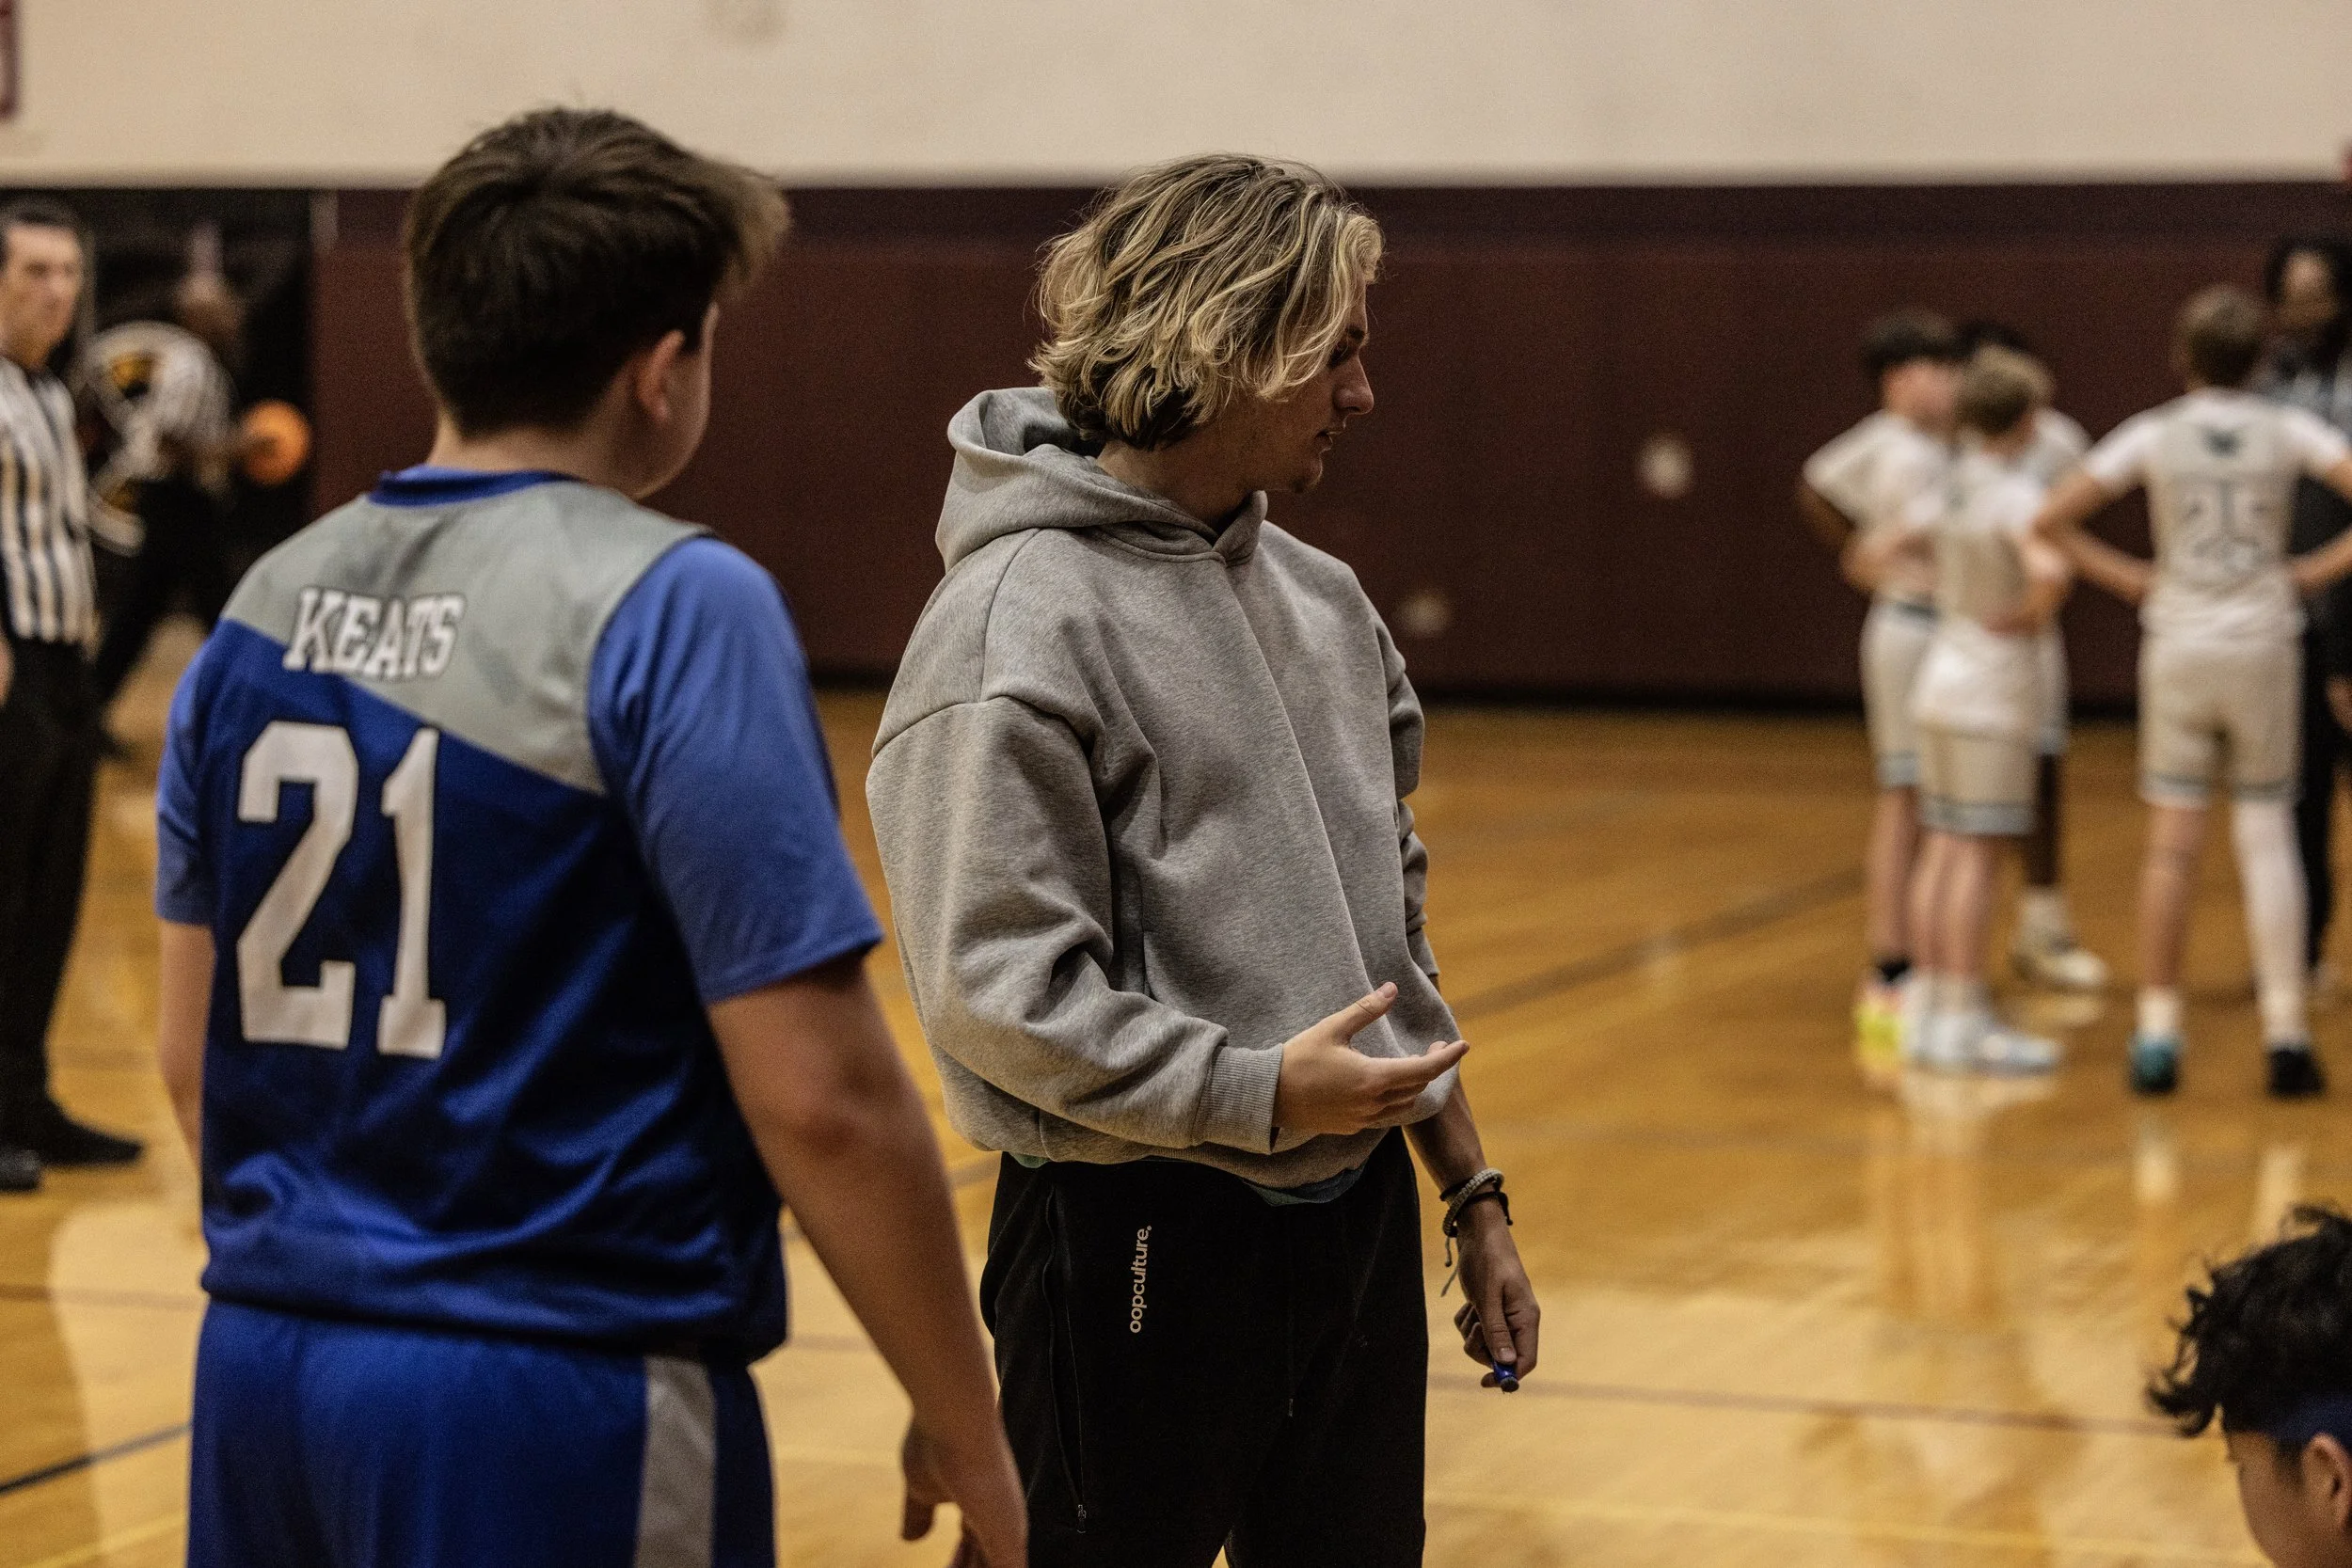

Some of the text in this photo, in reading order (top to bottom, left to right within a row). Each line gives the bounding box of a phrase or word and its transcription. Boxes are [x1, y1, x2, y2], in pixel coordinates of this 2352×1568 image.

[283, 586, 467, 682] KEATS
[236, 721, 447, 1059] 21
[1129, 1225, 1152, 1334] oopculture.
